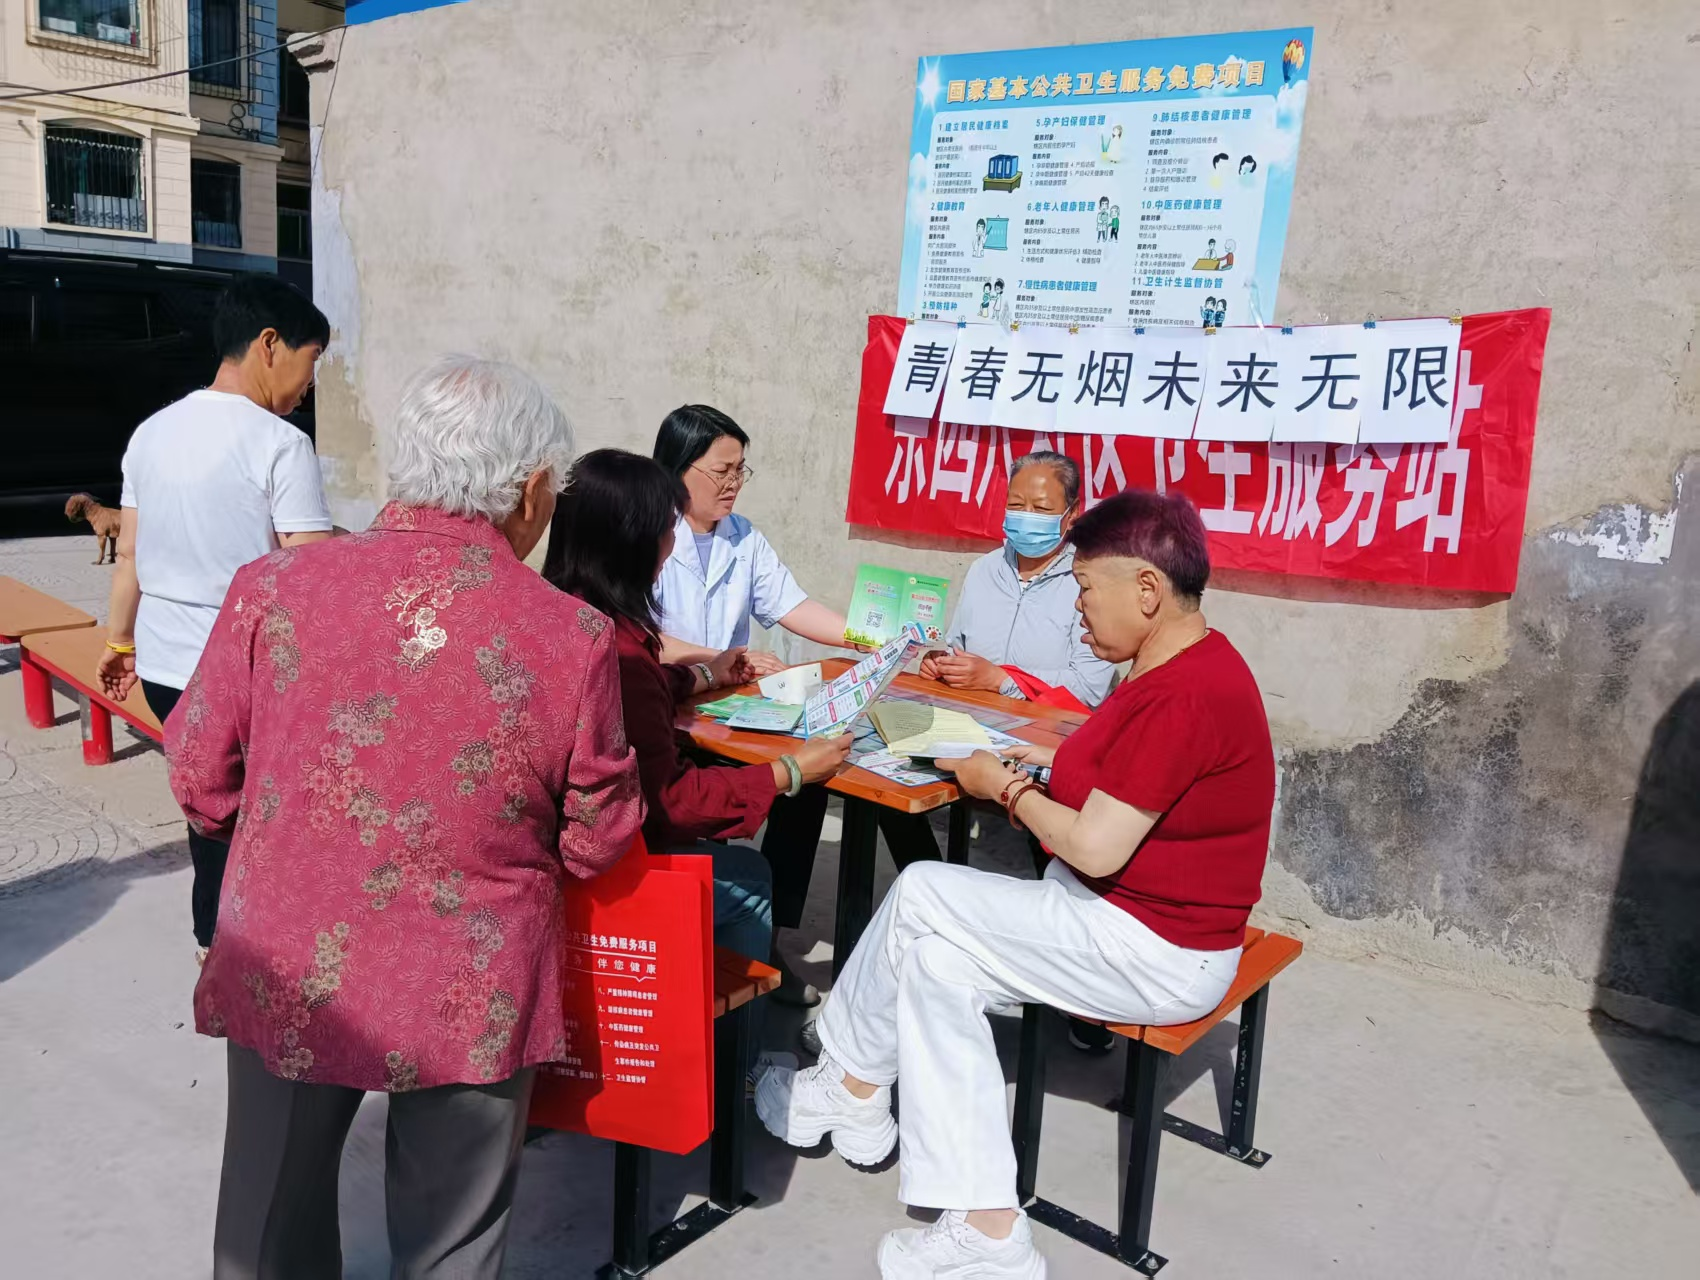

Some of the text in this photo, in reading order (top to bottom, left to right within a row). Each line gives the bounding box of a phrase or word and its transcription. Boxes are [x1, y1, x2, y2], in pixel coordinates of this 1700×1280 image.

[946, 60, 1265, 104] 国家基本公共卫生服务免费项目
[1036, 115, 1106, 127] 5.孕产妇保健管理
[1152, 108, 1252, 122] 9.肺结核患者健康管理
[1027, 201, 1095, 212] 6.老年人健康管理
[1141, 199, 1222, 210] 10.中医药健康管理
[1018, 280, 1097, 292] 7.慢性病患者健康管理
[1132, 276, 1223, 289] 11.卫生计生监督协管
[905, 341, 1450, 413] 青春无烟未来无限
